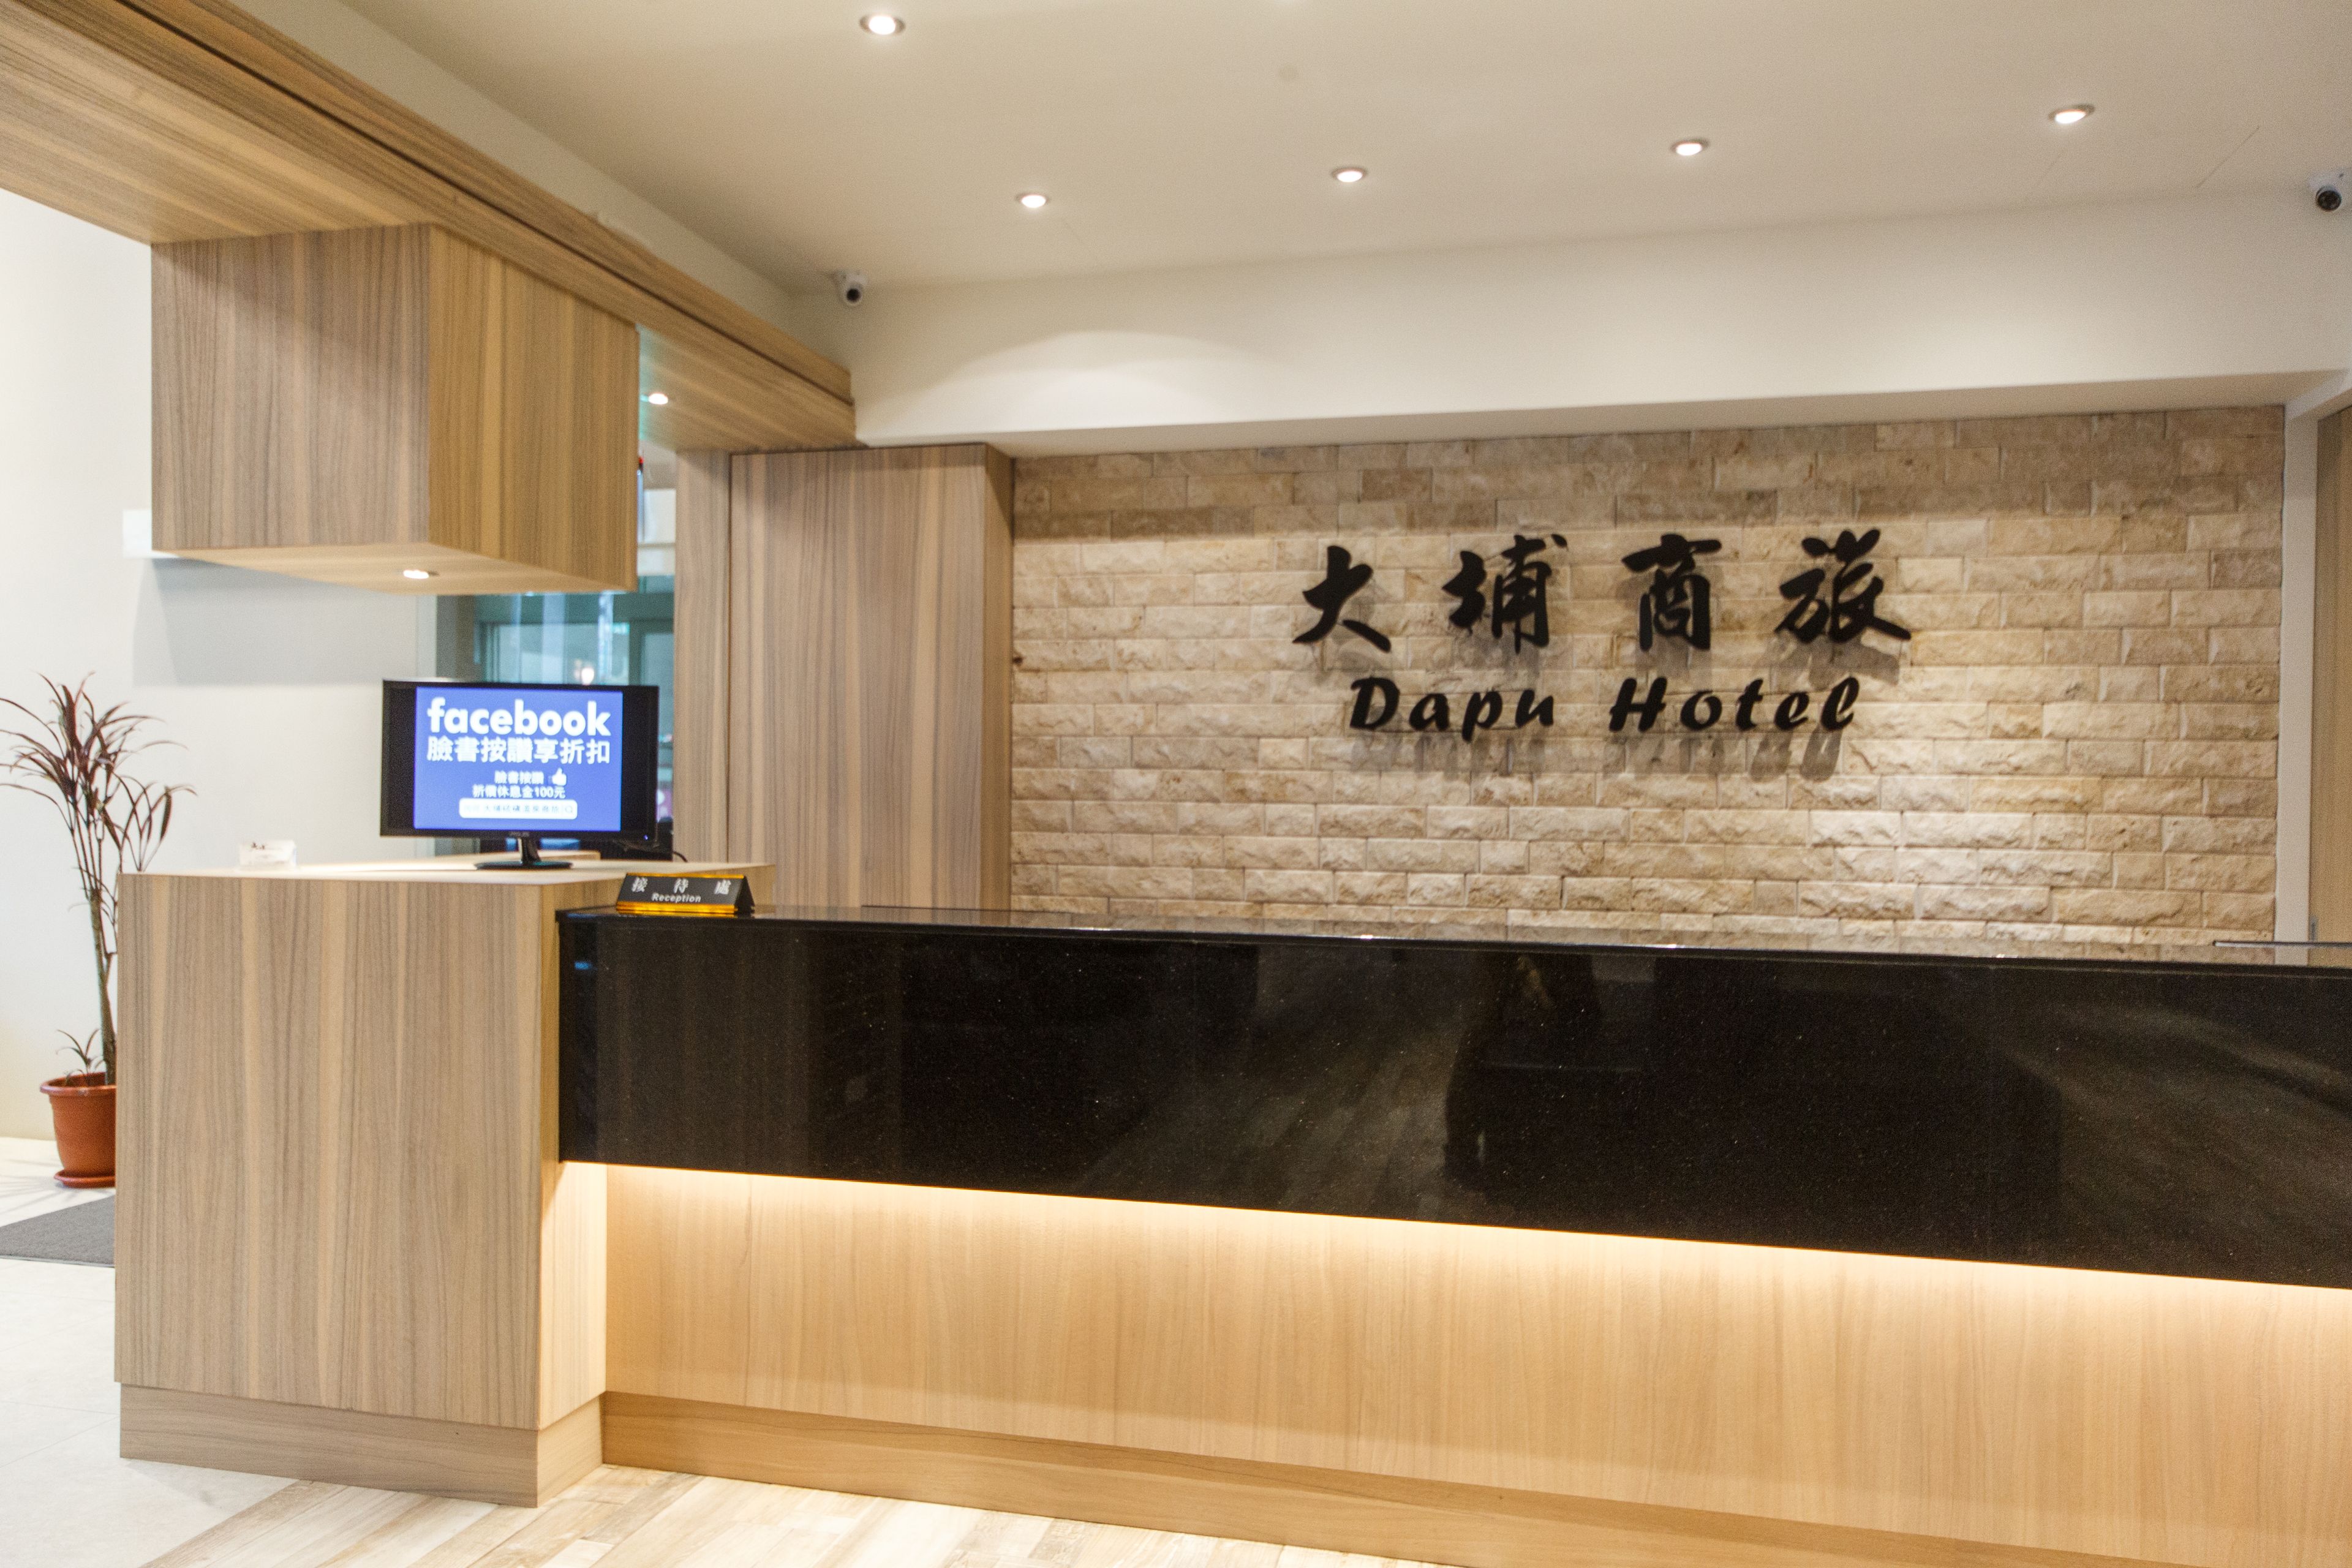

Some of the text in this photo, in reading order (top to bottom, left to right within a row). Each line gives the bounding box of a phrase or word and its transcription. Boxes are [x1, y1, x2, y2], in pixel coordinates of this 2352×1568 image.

[1291, 528, 1912, 653] 大埔商旅
[427, 697, 611, 736] facebook
[1349, 676, 1860, 742] Dapu Hotel
[652, 893, 701, 903] Reception
